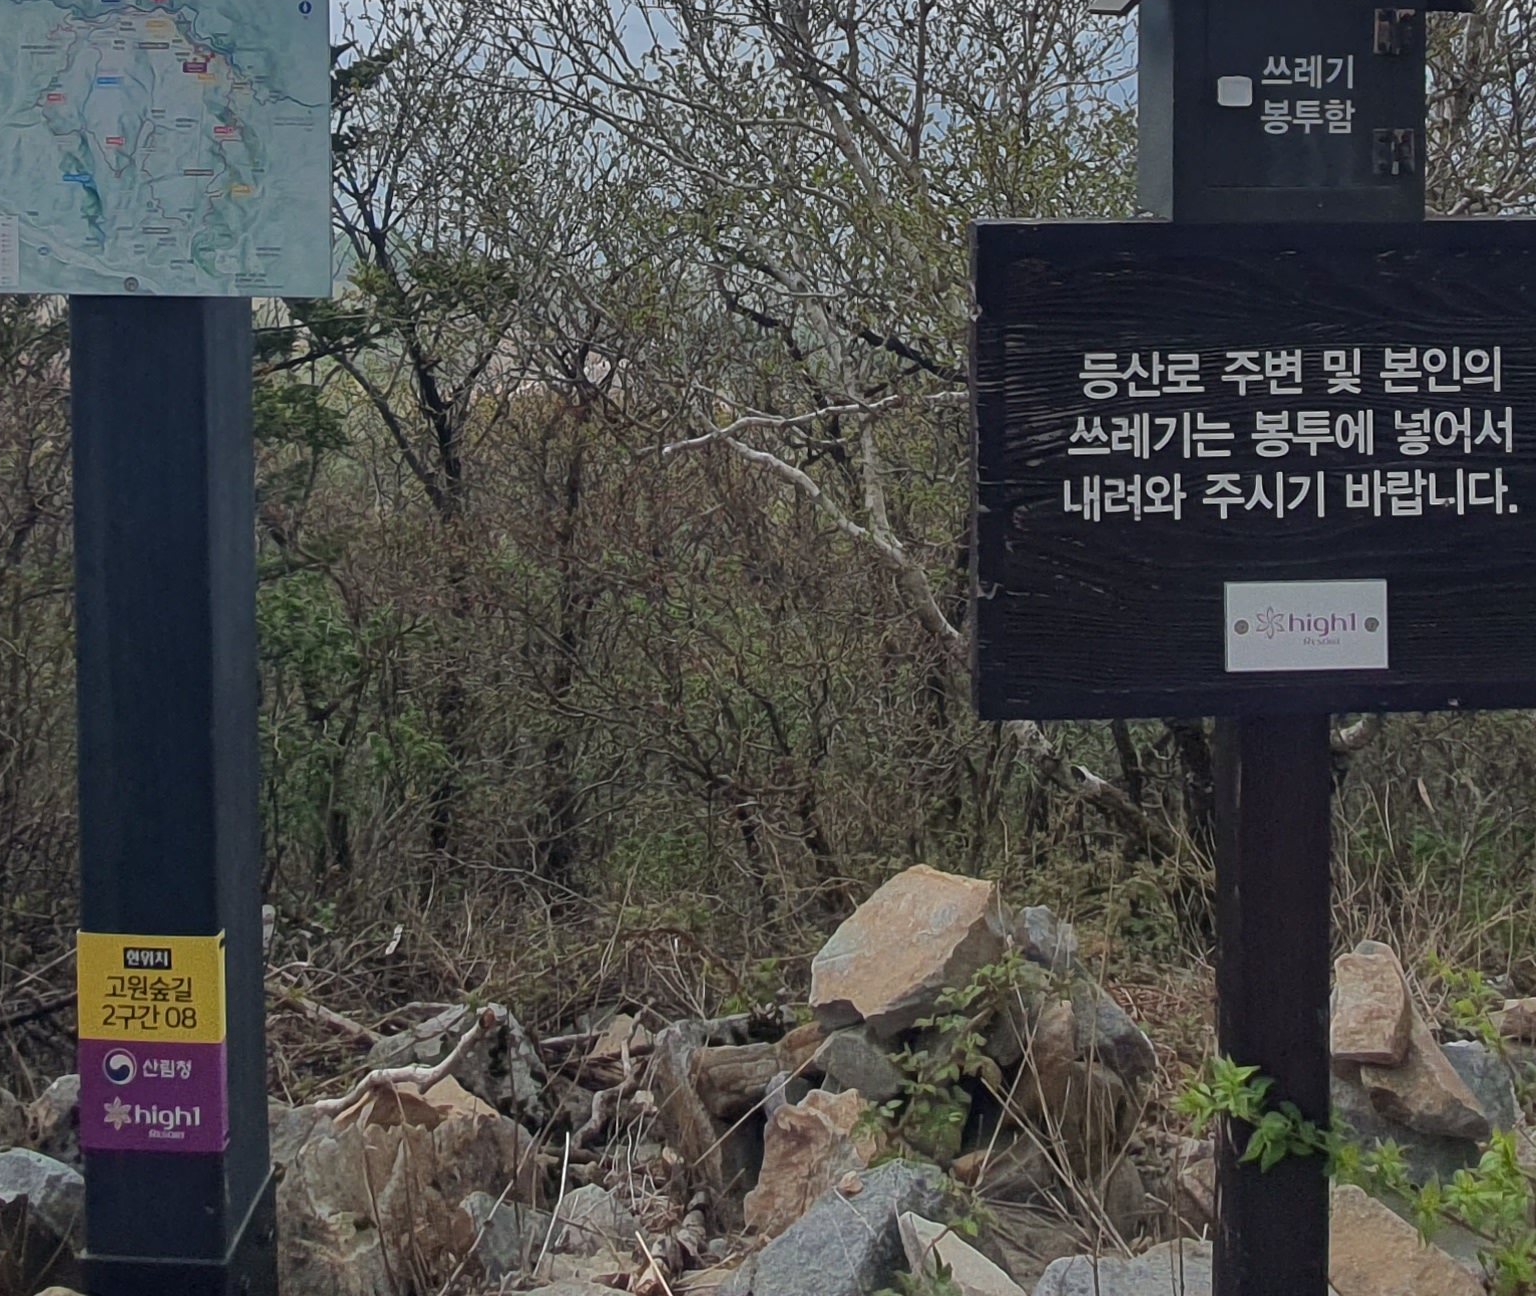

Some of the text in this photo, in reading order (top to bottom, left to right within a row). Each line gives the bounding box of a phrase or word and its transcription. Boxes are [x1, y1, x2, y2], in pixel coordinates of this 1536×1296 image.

[1261, 55, 1353, 89] 쓰레기
[1260, 99, 1355, 134] 봉투함
[1079, 346, 1502, 399] 등산로 주변 및 본인의
[1068, 406, 1512, 459] 쓰레기는 봉투에 넣어서
[1064, 468, 1518, 522] 내려와 주시기 바랍니다.
[1288, 613, 1356, 636] high1
[105, 975, 193, 1002] 고원숲길
[102, 1003, 197, 1030] 2구간 08
[142, 1059, 193, 1079] 산림청
[134, 1104, 200, 1130] high1
